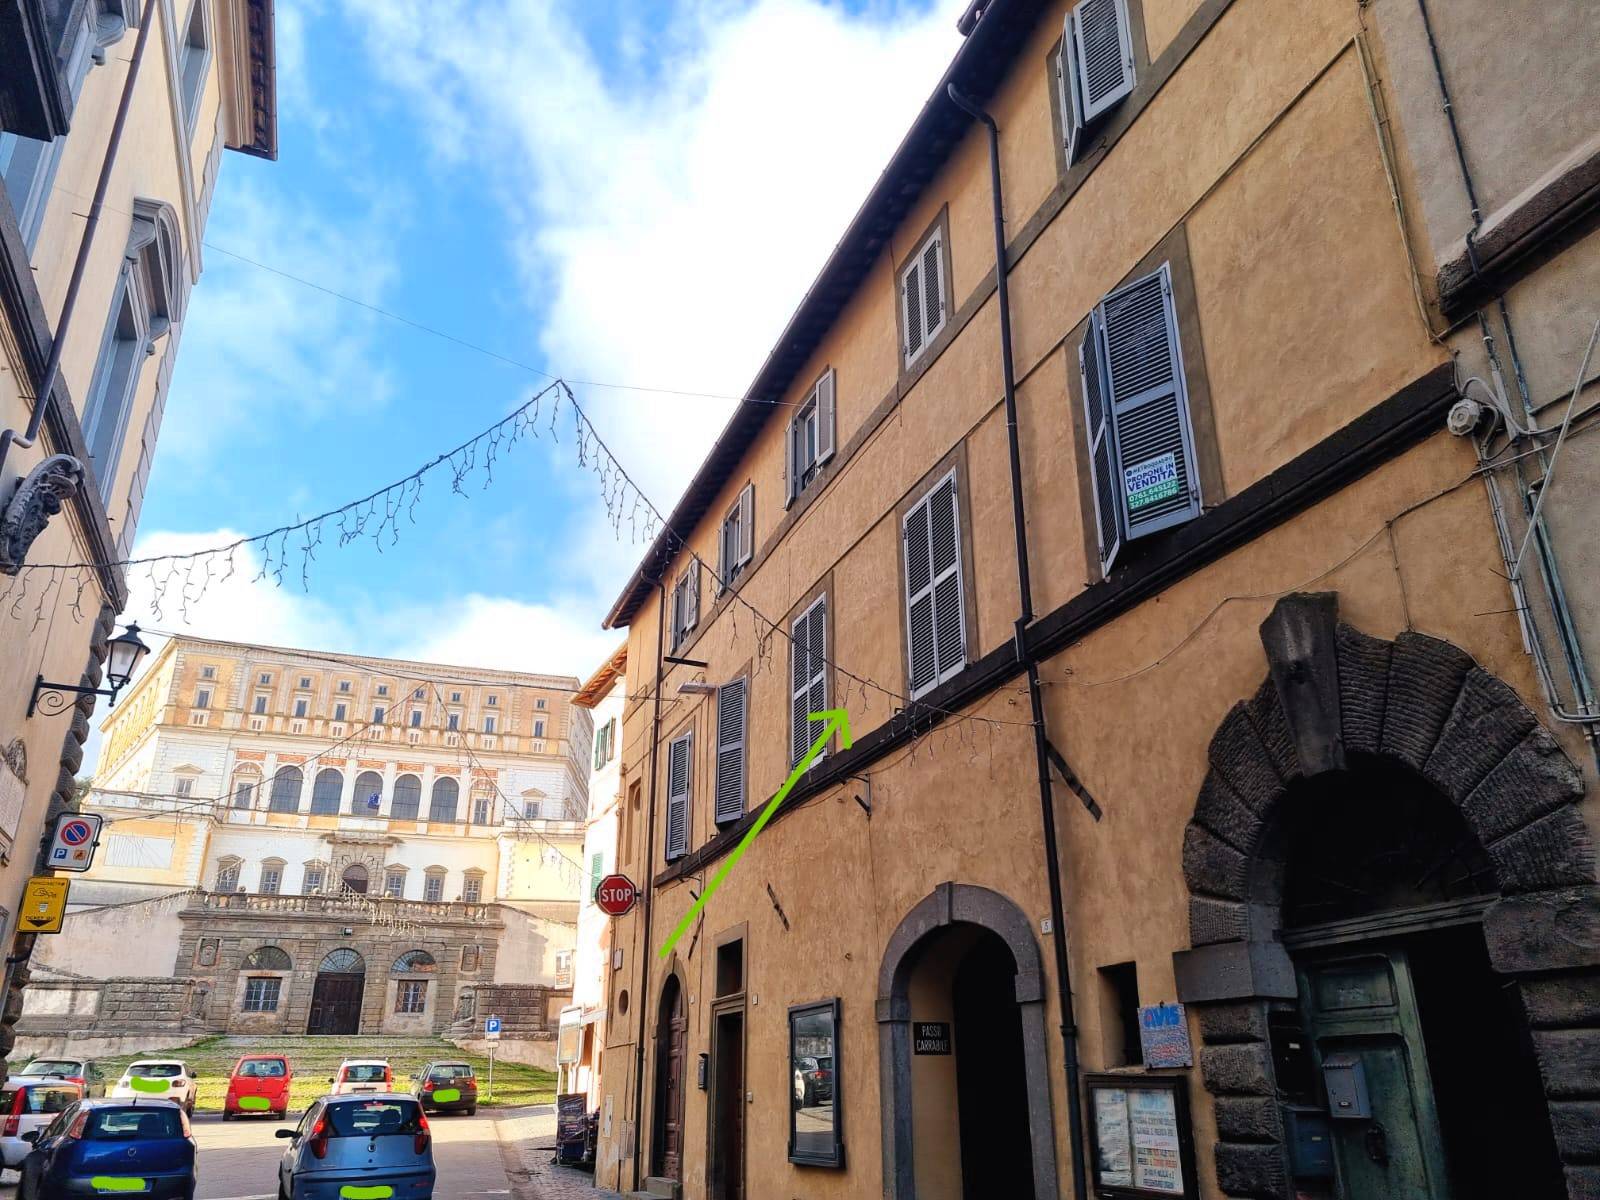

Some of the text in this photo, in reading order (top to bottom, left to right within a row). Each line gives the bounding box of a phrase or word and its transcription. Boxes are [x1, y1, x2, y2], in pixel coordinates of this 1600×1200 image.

[1127, 462, 1174, 485] PROPONE IN
[1128, 470, 1175, 491] VENDITA
[601, 888, 632, 902] STOP
[1143, 1006, 1180, 1028] AVIS
[489, 1020, 498, 1031] P
[921, 1024, 942, 1037] PASSO
[916, 1040, 949, 1052] CARRABILE
